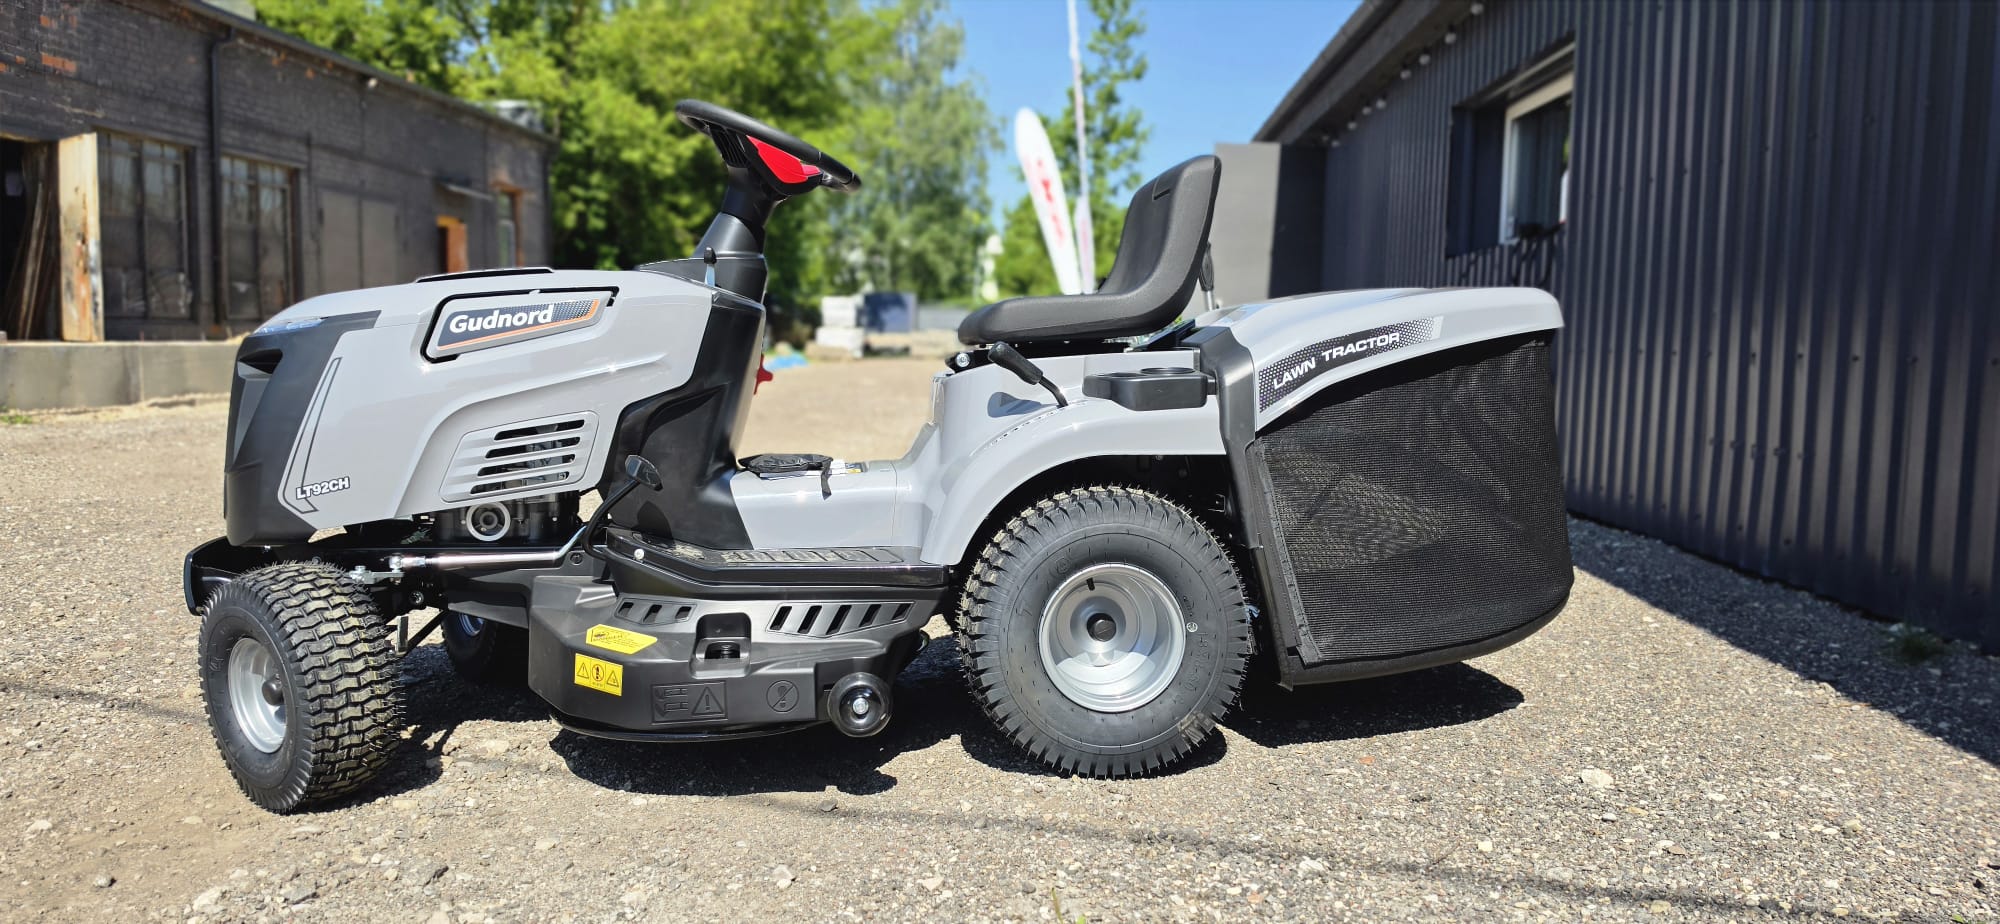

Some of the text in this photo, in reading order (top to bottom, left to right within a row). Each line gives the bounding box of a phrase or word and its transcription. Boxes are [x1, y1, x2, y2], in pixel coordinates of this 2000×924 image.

[450, 304, 554, 333] Gudnord
[1273, 332, 1400, 389] LAWN TRACTOR
[296, 476, 350, 500] LT92CH
